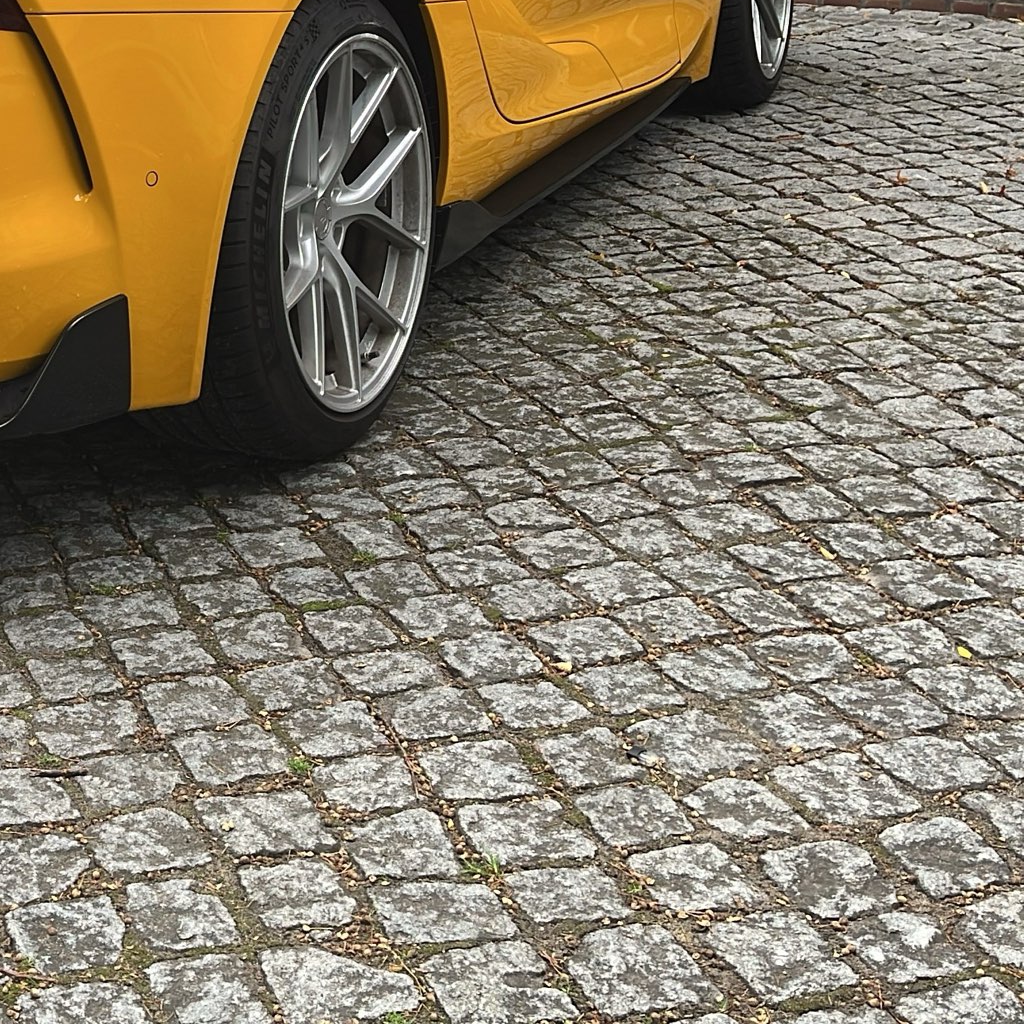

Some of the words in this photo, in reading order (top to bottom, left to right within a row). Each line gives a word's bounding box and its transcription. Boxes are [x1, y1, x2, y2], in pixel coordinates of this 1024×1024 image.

[267, 96, 284, 139] PILOT
[281, 50, 301, 93] SPORT
[252, 159, 273, 329] MICHELIN
